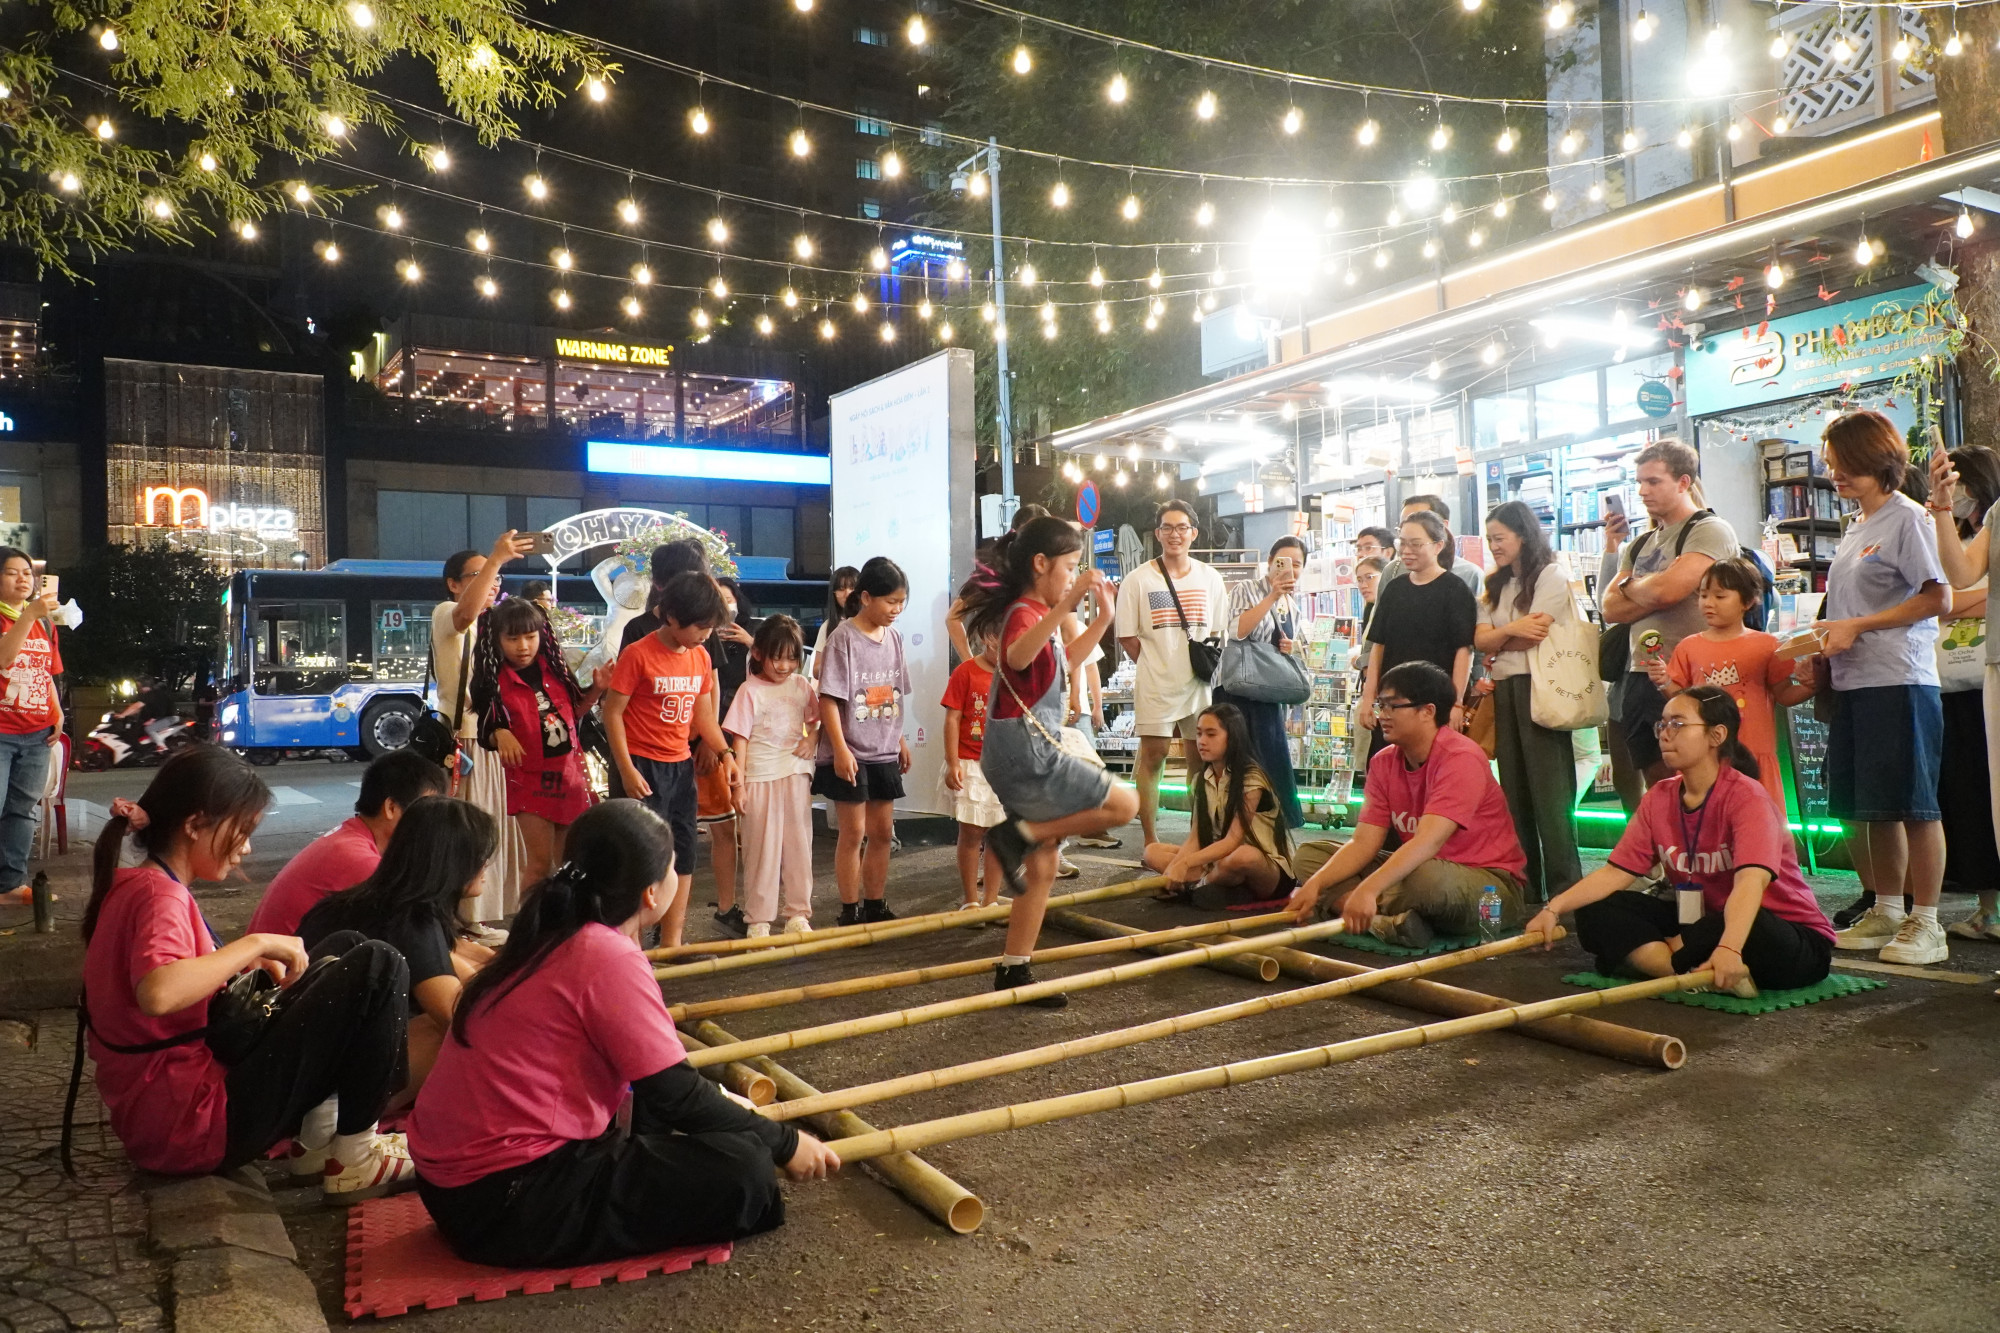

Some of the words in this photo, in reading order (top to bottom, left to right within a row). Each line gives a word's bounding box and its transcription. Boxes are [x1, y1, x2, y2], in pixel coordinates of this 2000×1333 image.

[1791, 302, 1948, 356] PHNBOOK
[556, 338, 628, 362] WARNING
[630, 346, 670, 366] ZONE
[209, 502, 294, 535] plaza
[384, 612, 402, 627] 19
[653, 675, 702, 695] FAIRPLA
[854, 669, 900, 685] FRIENDS
[660, 694, 696, 723] 96
[1657, 843, 1735, 874] Konni
